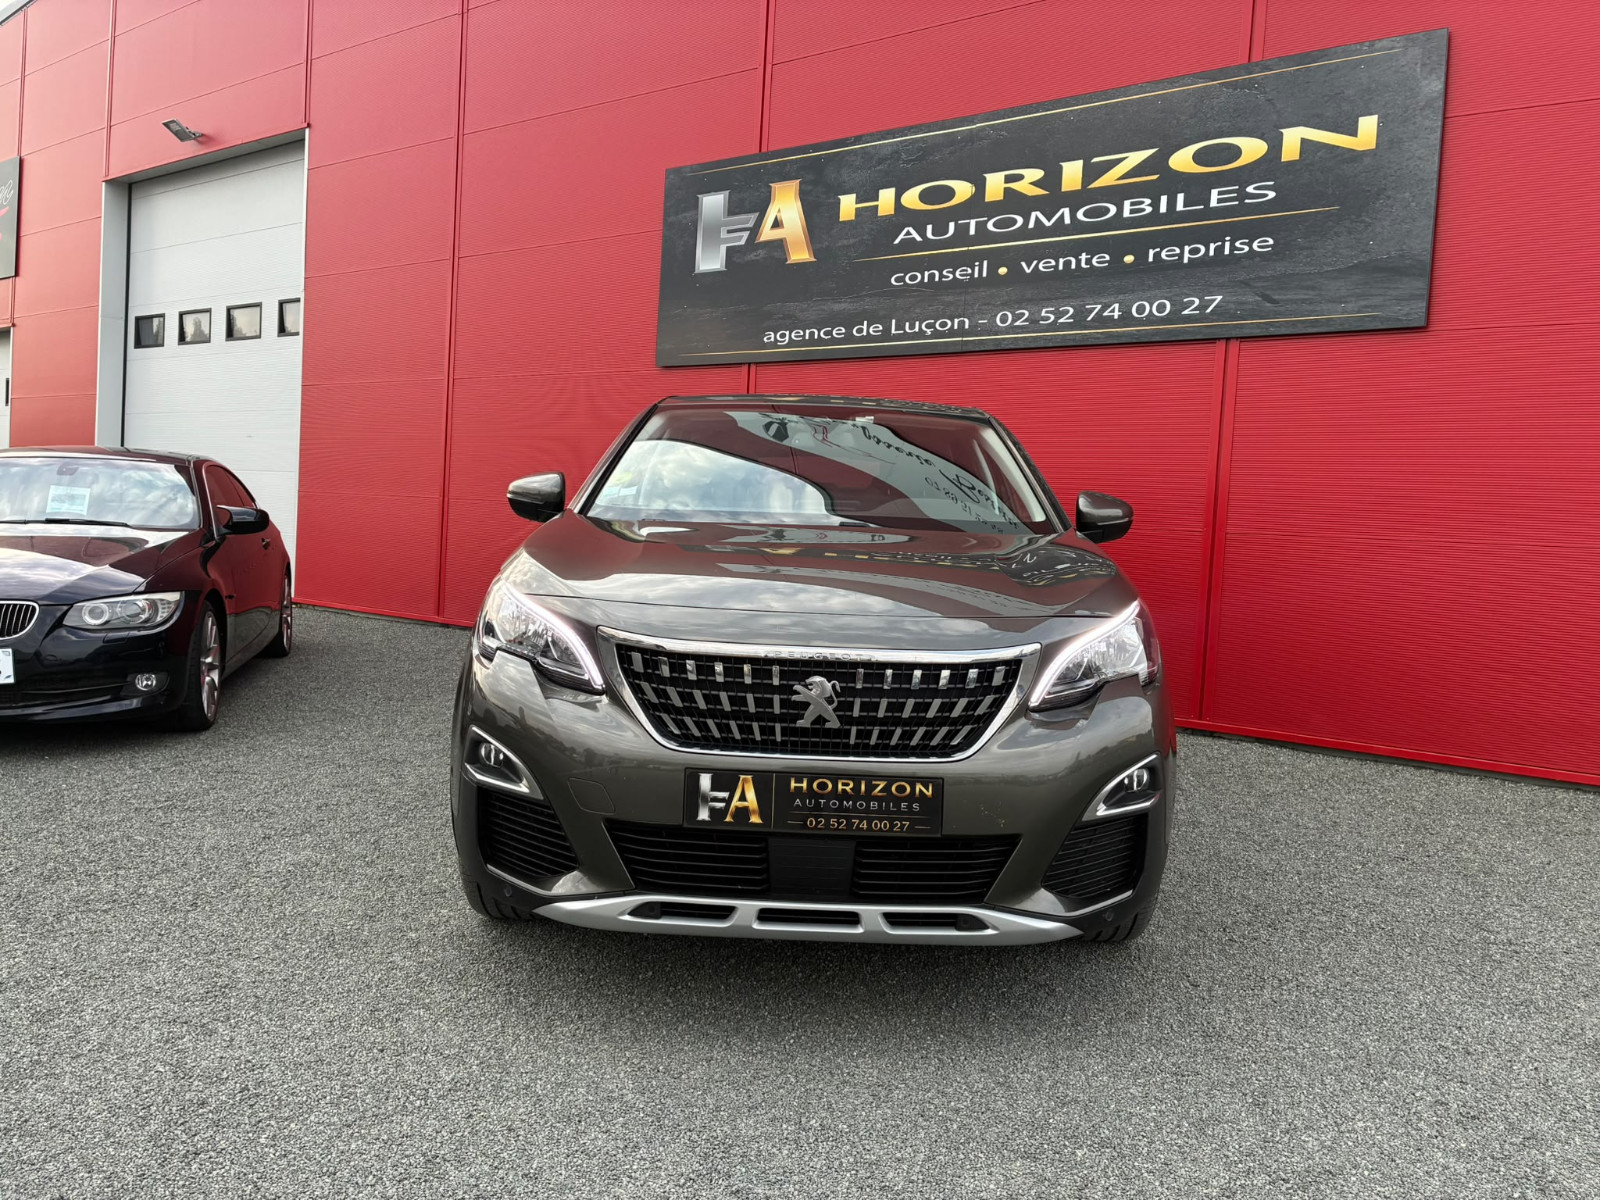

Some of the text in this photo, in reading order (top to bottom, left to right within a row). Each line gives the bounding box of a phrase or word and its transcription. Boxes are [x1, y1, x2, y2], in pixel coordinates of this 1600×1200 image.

[838, 114, 1379, 222] HORIZON
[893, 181, 1277, 245] AUTOMOBILES
[890, 236, 1275, 286] conseil vente reprise
[763, 325, 846, 345] agence
[852, 320, 884, 337] de
[890, 315, 970, 336] Luçon
[995, 310, 1031, 328] 02
[1039, 306, 1075, 325] 52
[1085, 303, 1123, 321] 74
[1131, 299, 1172, 318] 00
[1181, 295, 1224, 316] 27
[773, 650, 864, 662] PEUGEOT
[789, 776, 934, 799] HORIZON
[793, 798, 921, 812] AUTOMOBILES
[806, 817, 910, 832] 02 52 74 00 27
